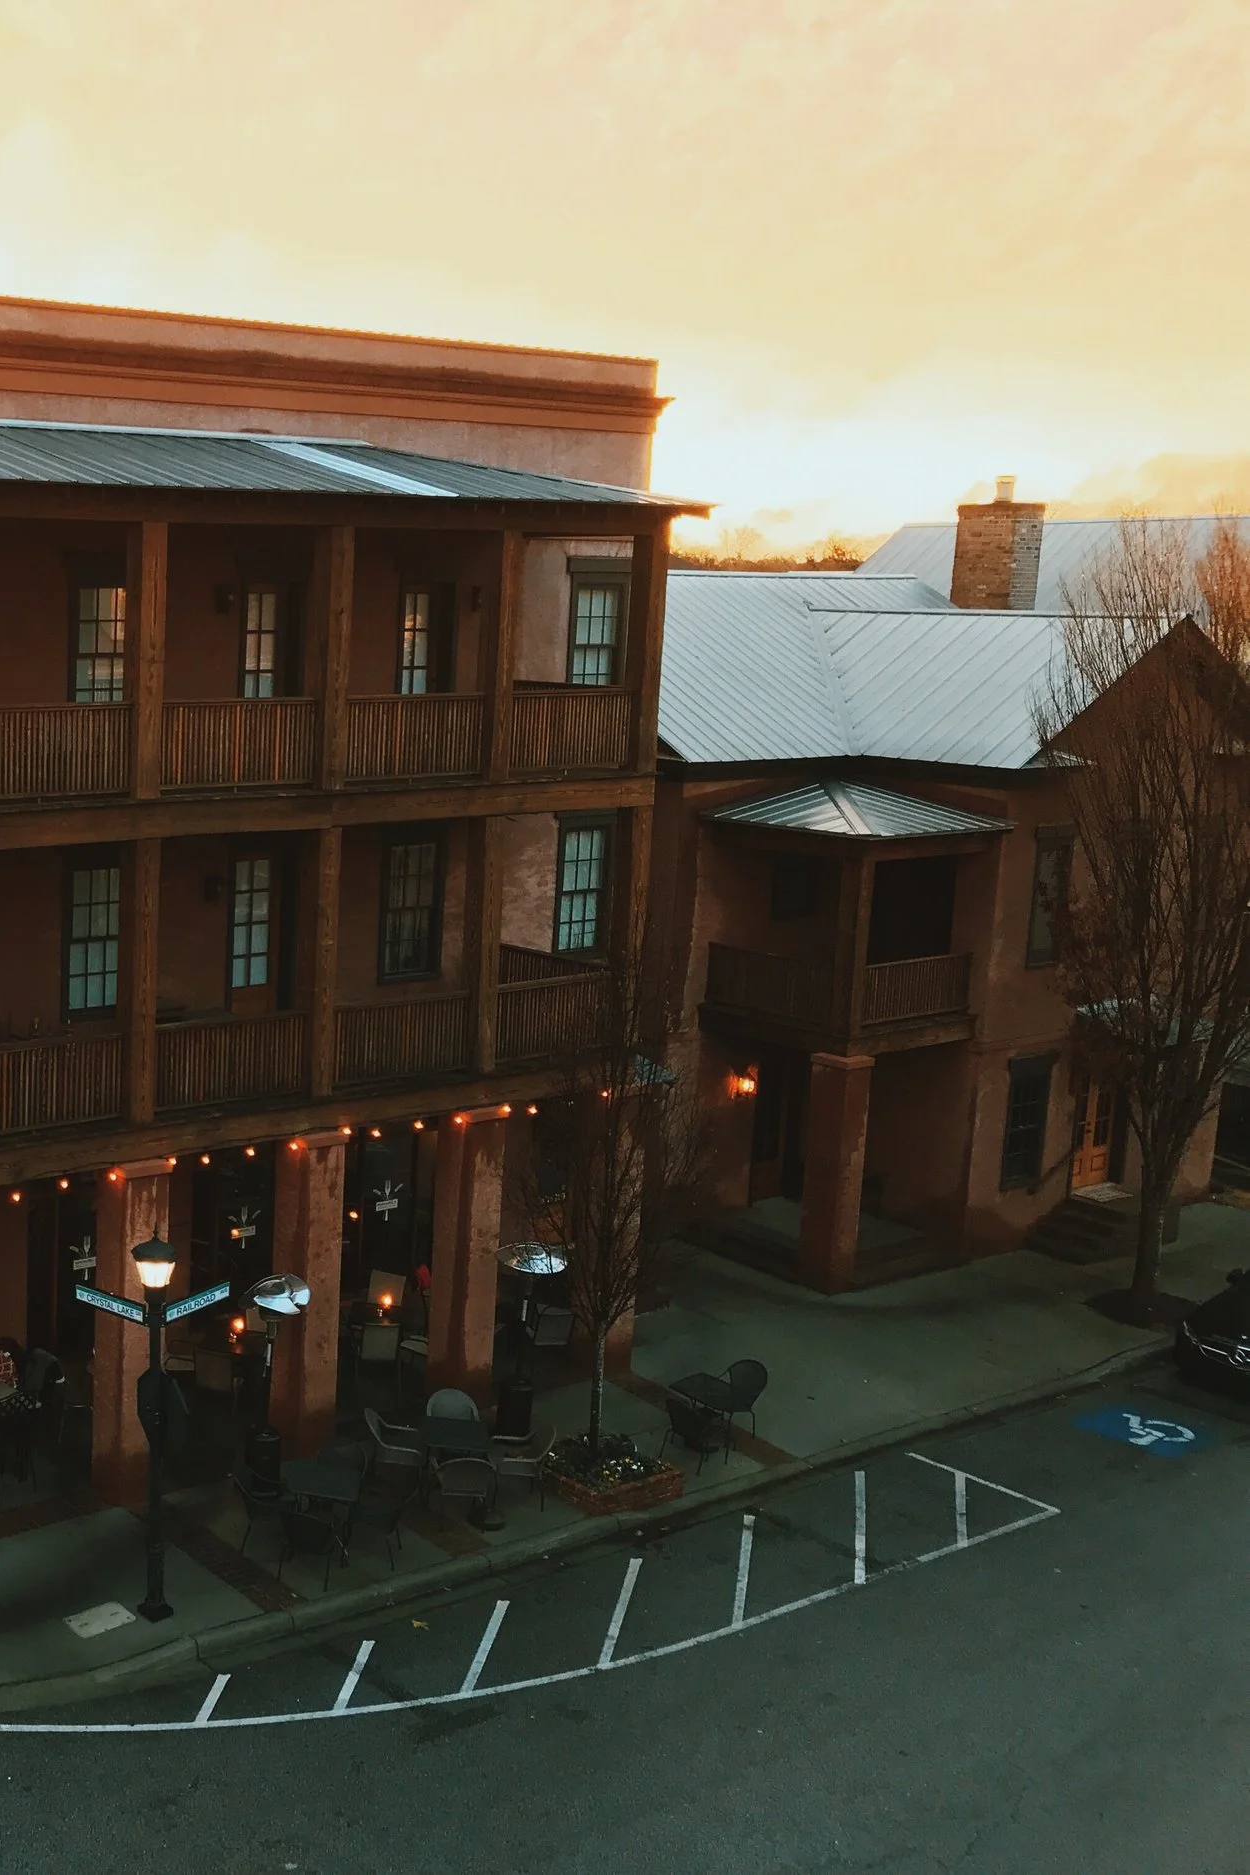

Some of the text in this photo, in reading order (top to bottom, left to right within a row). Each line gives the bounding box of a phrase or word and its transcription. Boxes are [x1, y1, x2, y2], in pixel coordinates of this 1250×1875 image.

[86, 1293, 115, 1311] CRYSTAL
[117, 1304, 135, 1318] LAKE
[176, 1293, 216, 1316] RAILROAD
